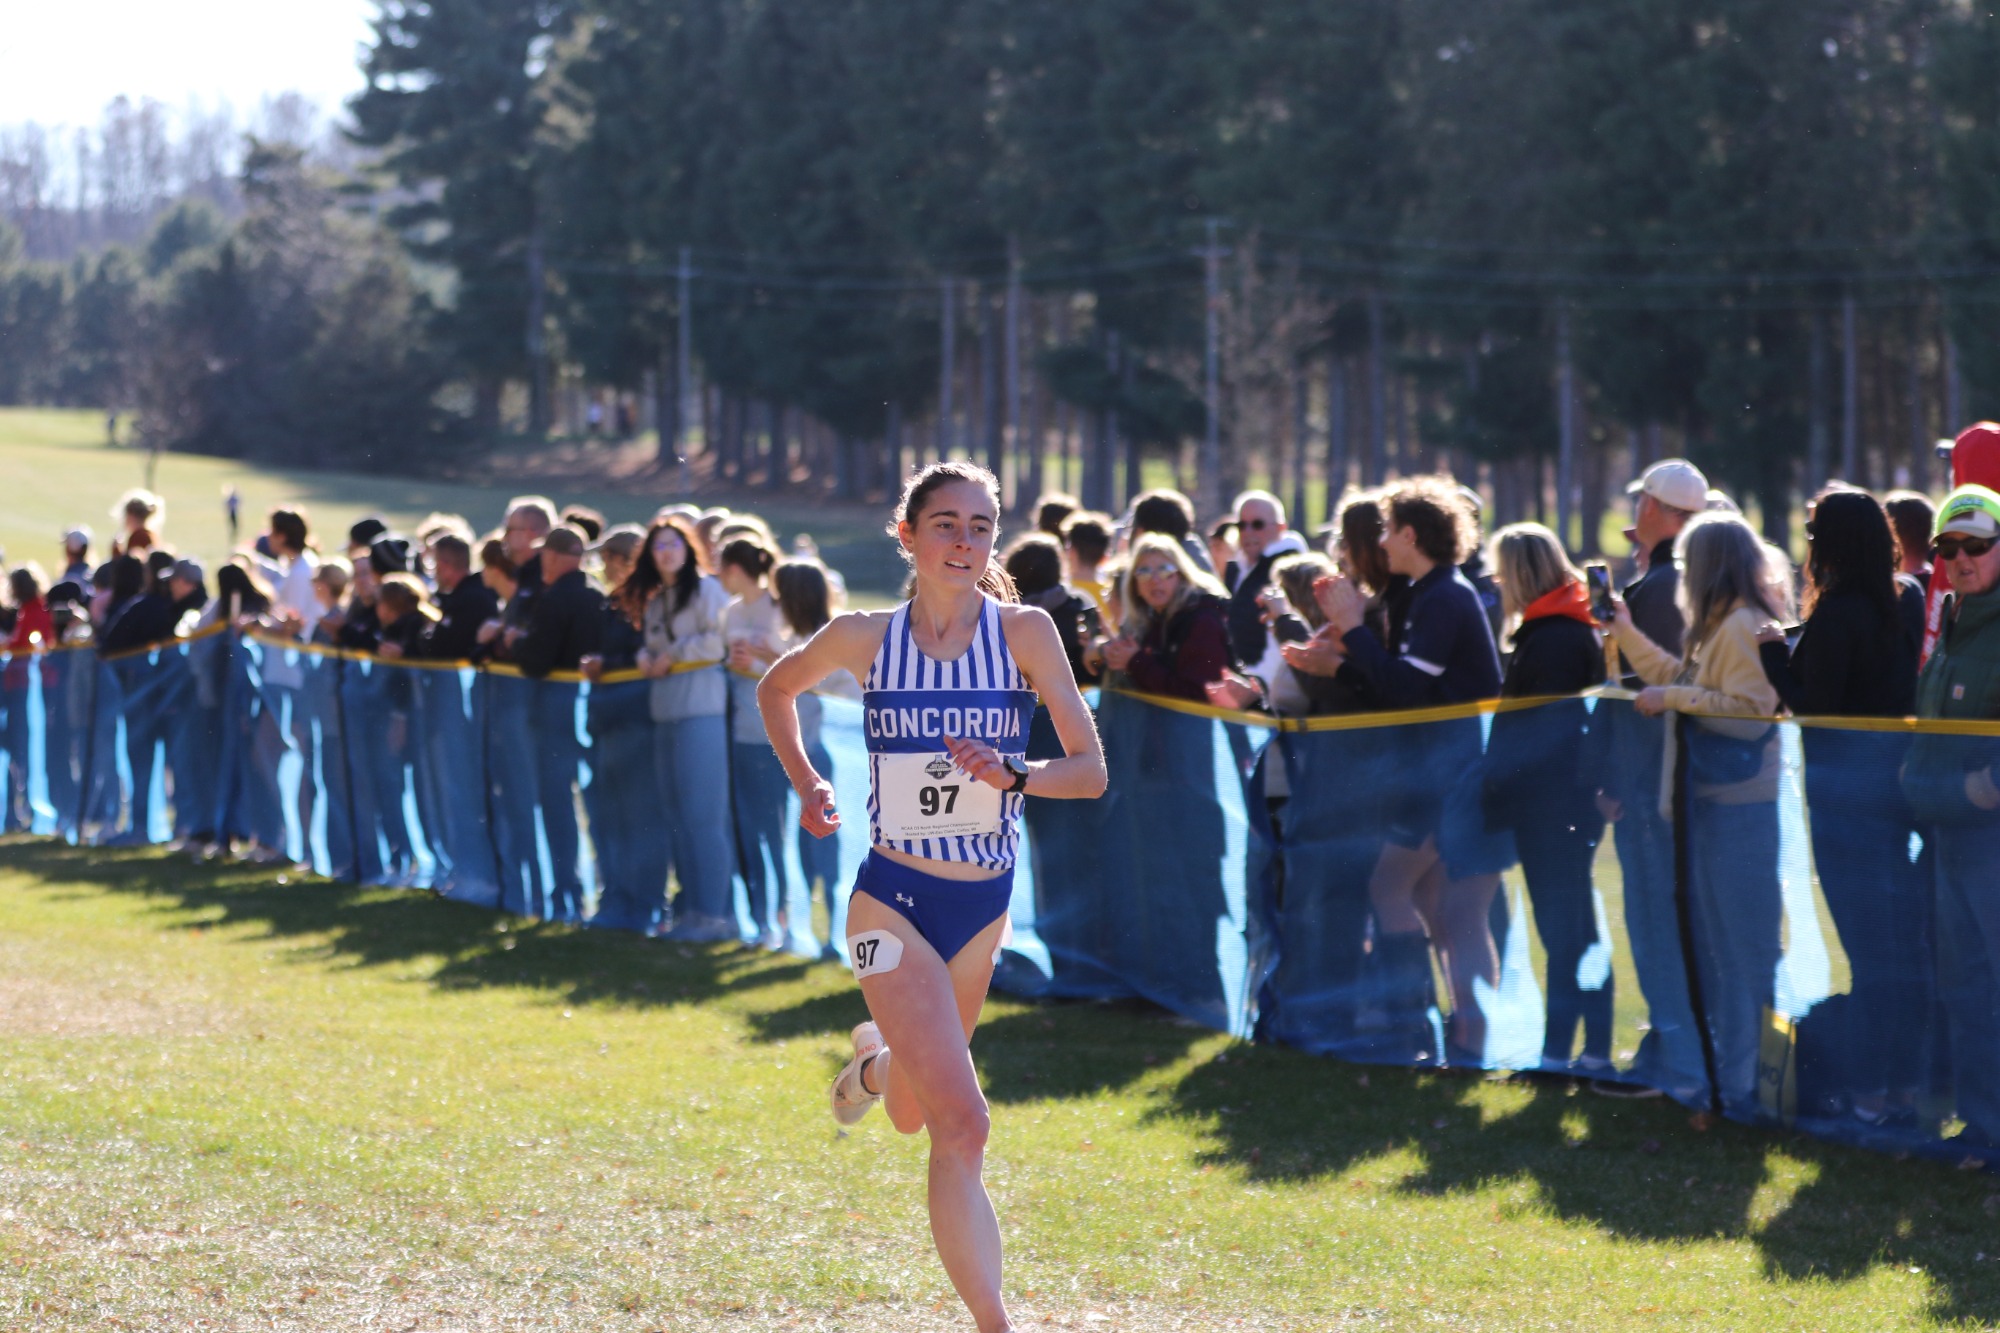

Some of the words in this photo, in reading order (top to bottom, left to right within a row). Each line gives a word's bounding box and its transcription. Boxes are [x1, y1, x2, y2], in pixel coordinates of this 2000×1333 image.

[868, 707, 1020, 738] CONCORDIA
[919, 785, 960, 816] 97
[856, 939, 880, 970] 97
